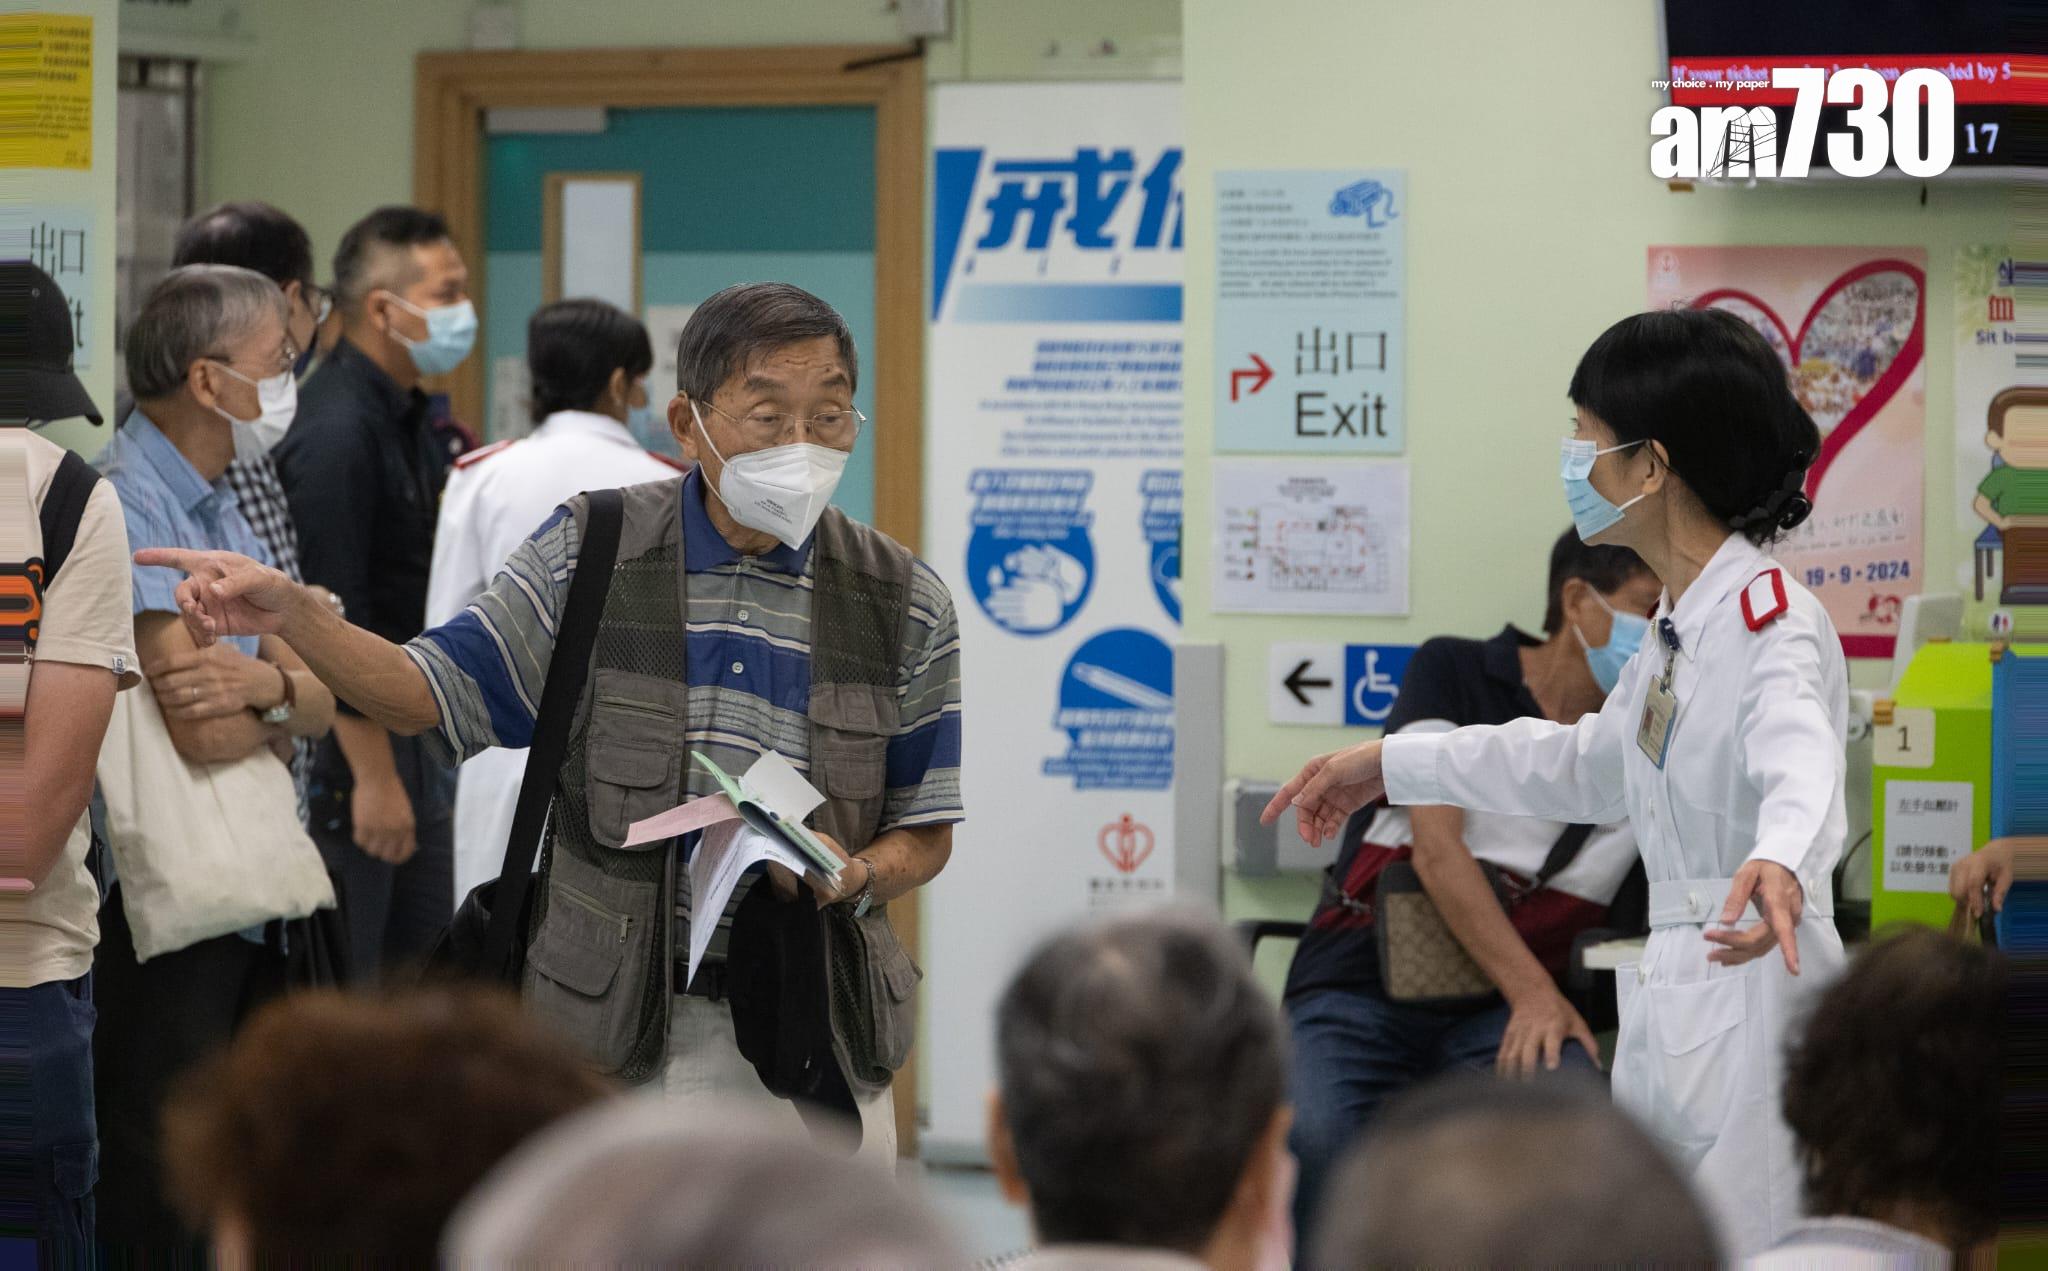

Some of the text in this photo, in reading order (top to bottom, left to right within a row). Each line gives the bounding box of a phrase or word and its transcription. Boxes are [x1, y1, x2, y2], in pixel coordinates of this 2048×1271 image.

[1977, 62, 1997, 84] by
[2002, 62, 2012, 80] 5
[1965, 123, 1999, 154] 17
[1976, 328, 1997, 345] Sit
[1296, 326, 1388, 376] 出口
[1296, 392, 1388, 438] Exit
[1897, 726, 1911, 751] 1
